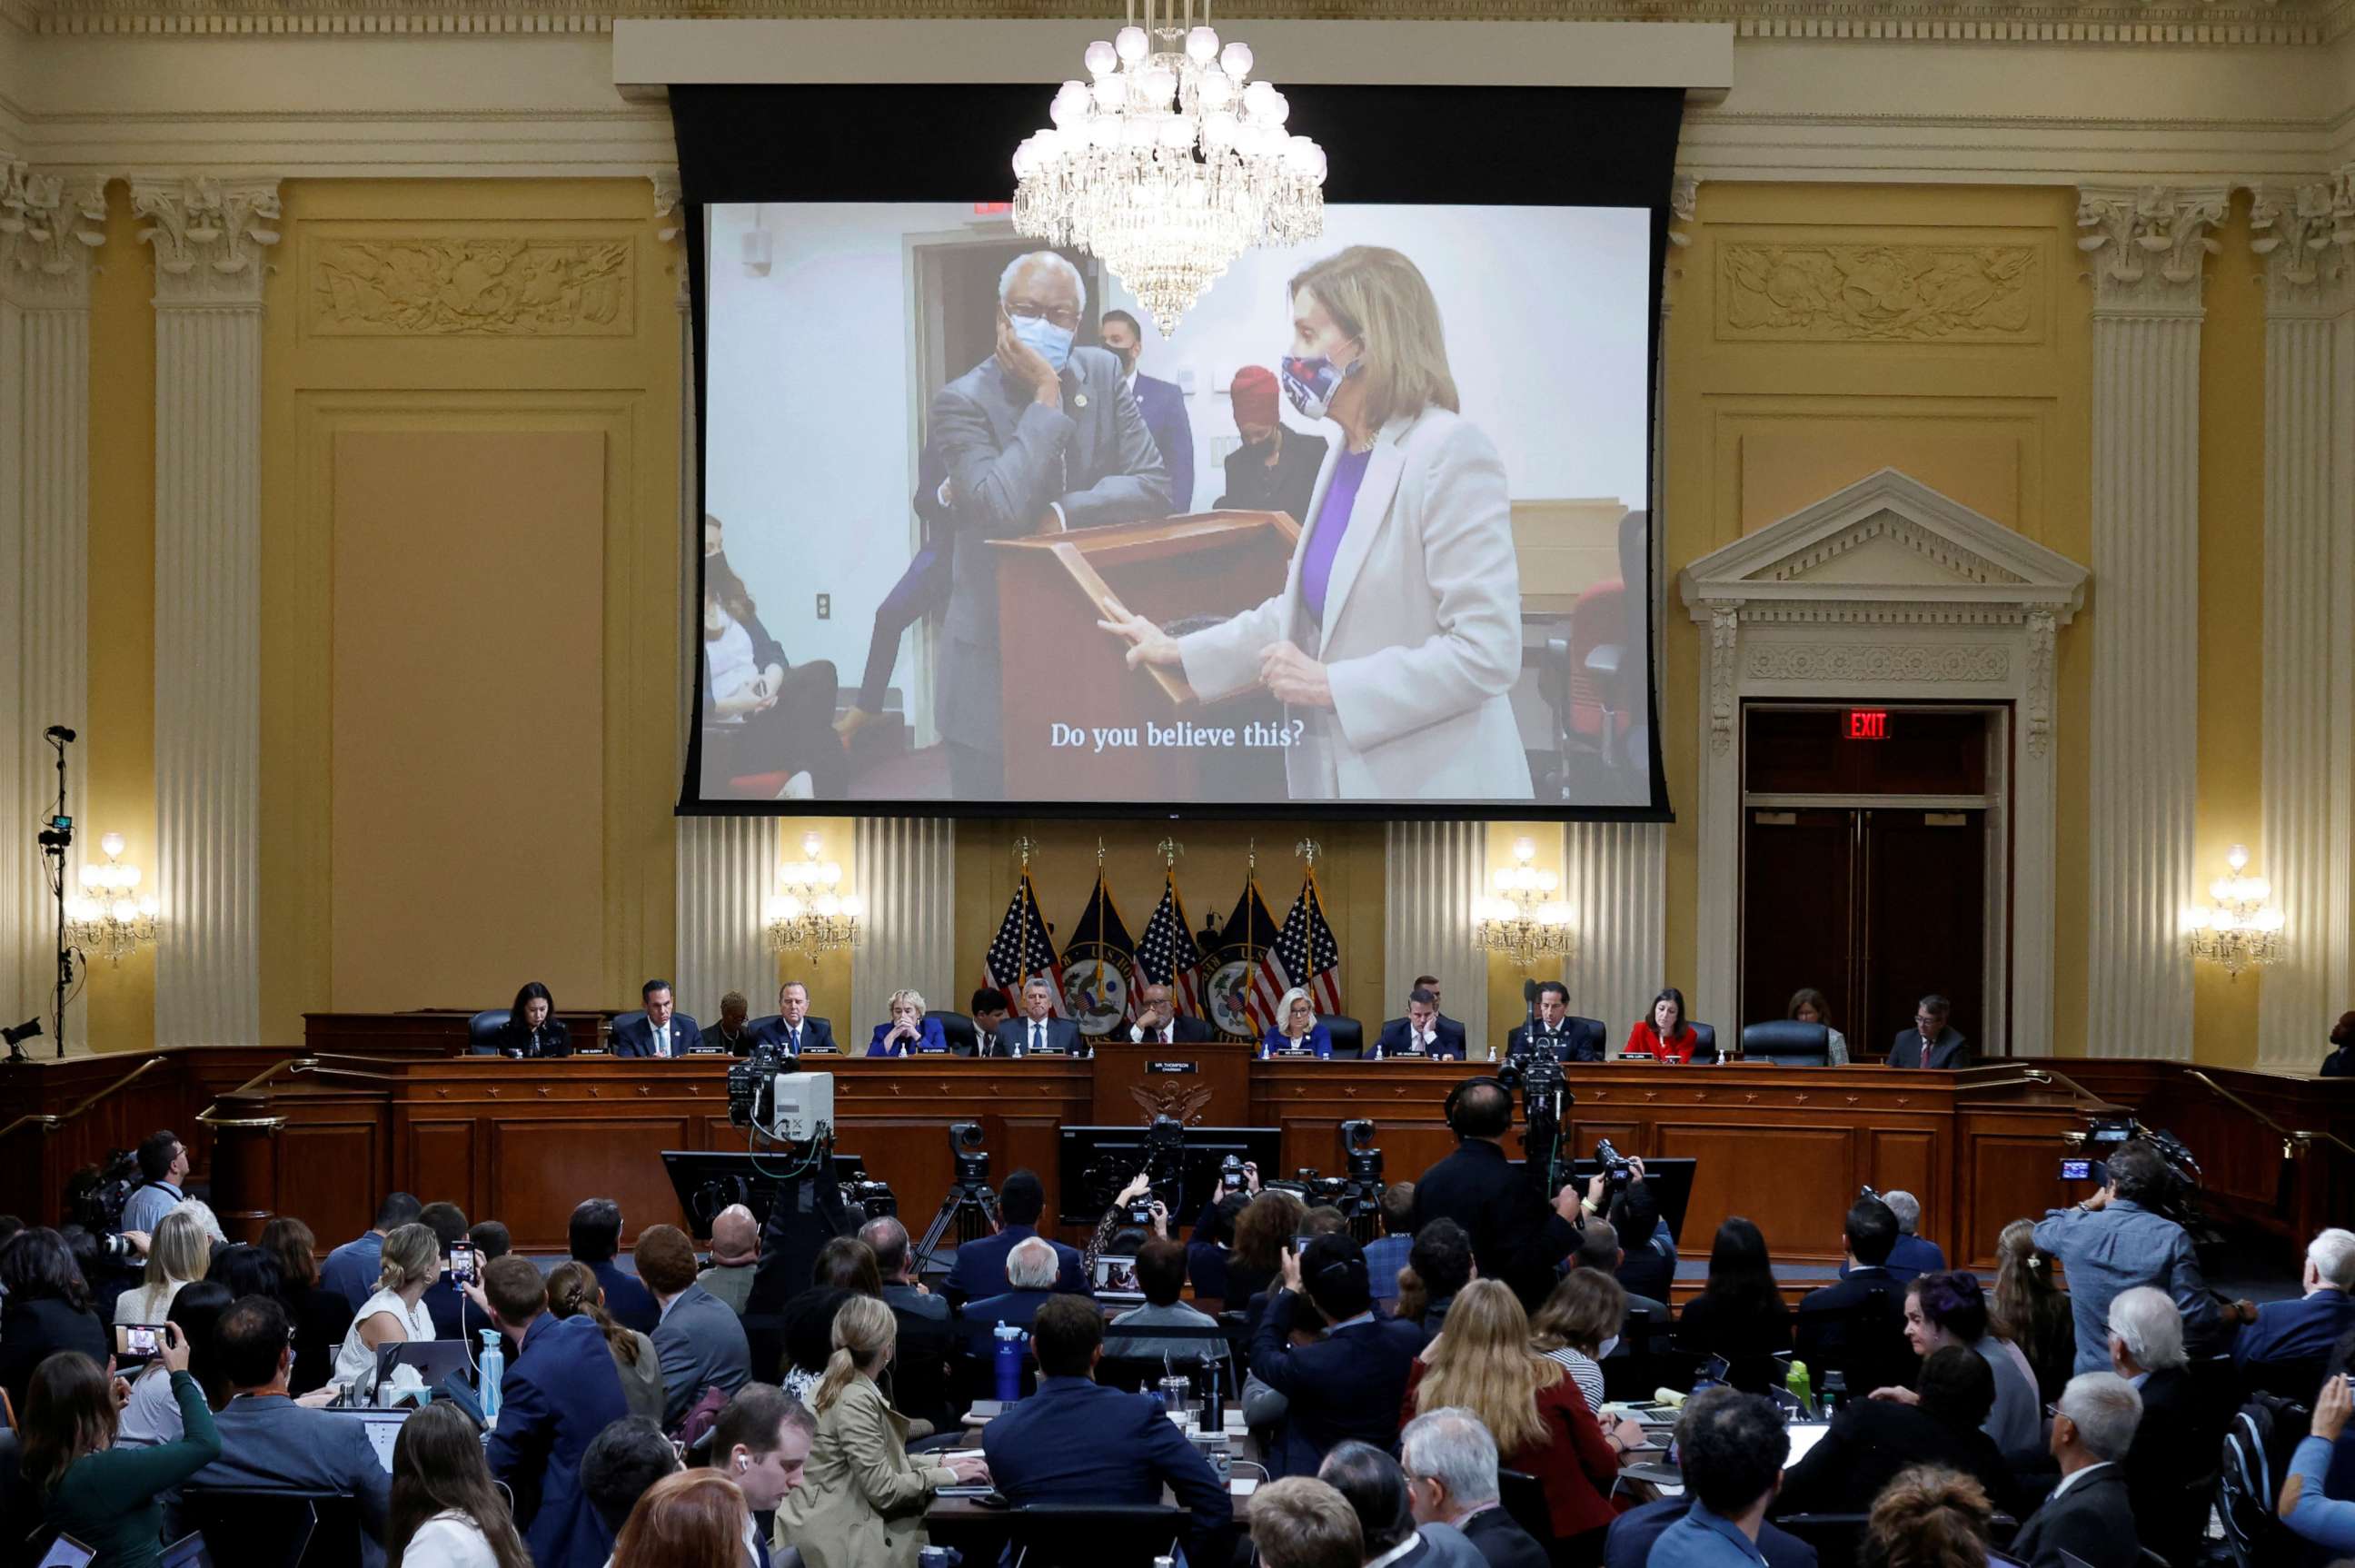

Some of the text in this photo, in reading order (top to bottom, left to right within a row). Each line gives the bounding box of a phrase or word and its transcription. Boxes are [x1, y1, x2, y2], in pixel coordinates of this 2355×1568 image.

[1051, 719, 1305, 753] Do you believe this?
[1851, 713, 1887, 737] EXIT
